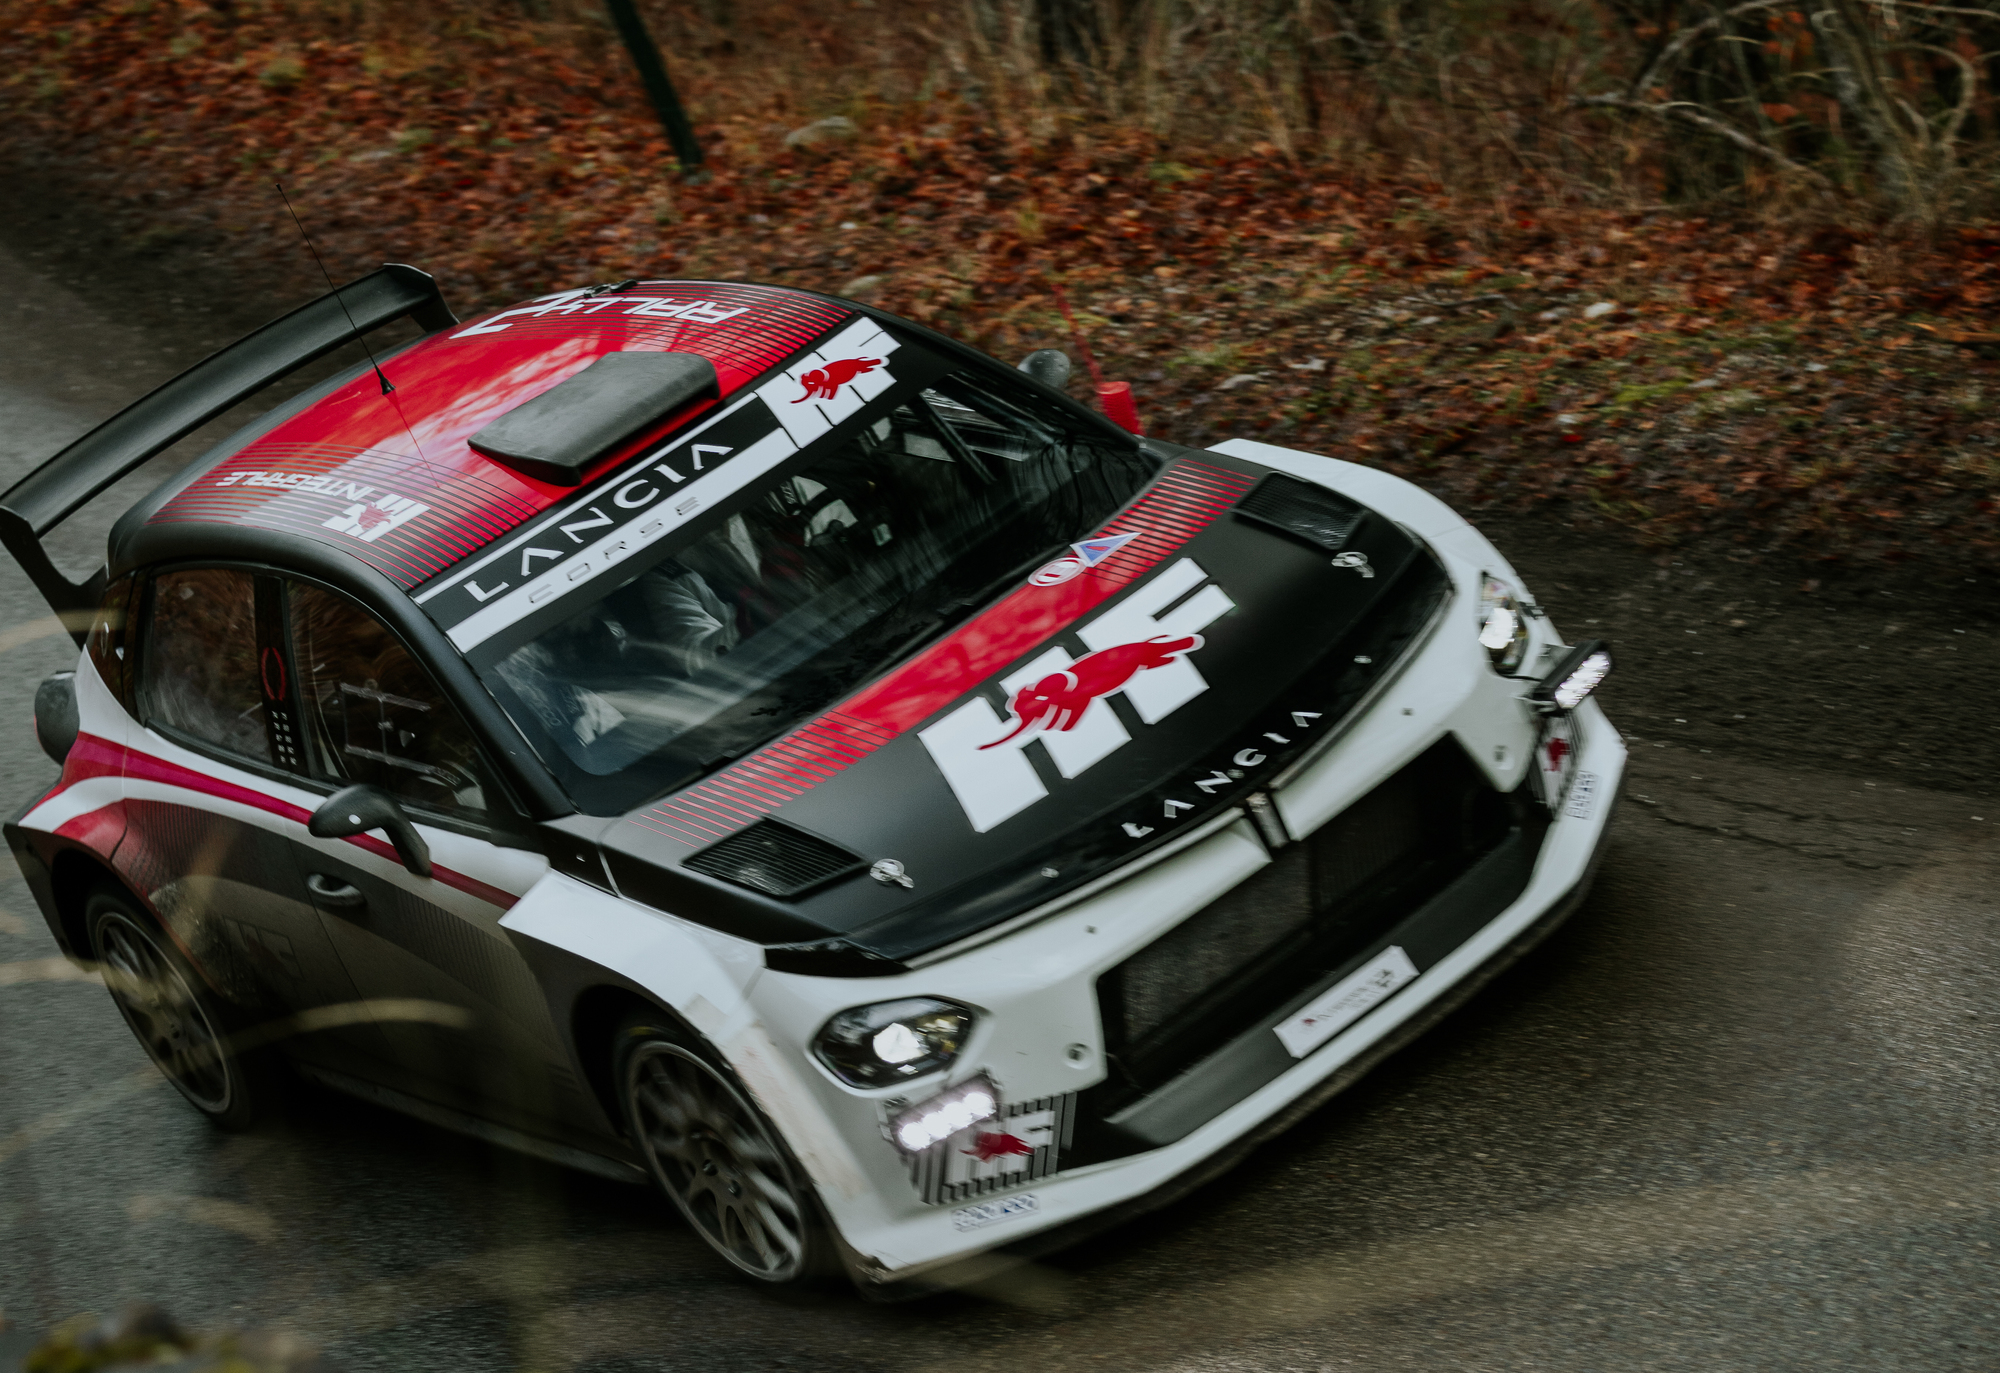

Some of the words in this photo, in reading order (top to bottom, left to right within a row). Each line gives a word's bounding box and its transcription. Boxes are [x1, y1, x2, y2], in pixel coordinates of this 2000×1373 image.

[756, 316, 902, 450] HF
[215, 469, 377, 503] INTEGRALE
[463, 443, 734, 603] LANCIA
[528, 497, 700, 604] CORSE
[917, 556, 1236, 834] HF
[1121, 711, 1322, 839] LANCIA
